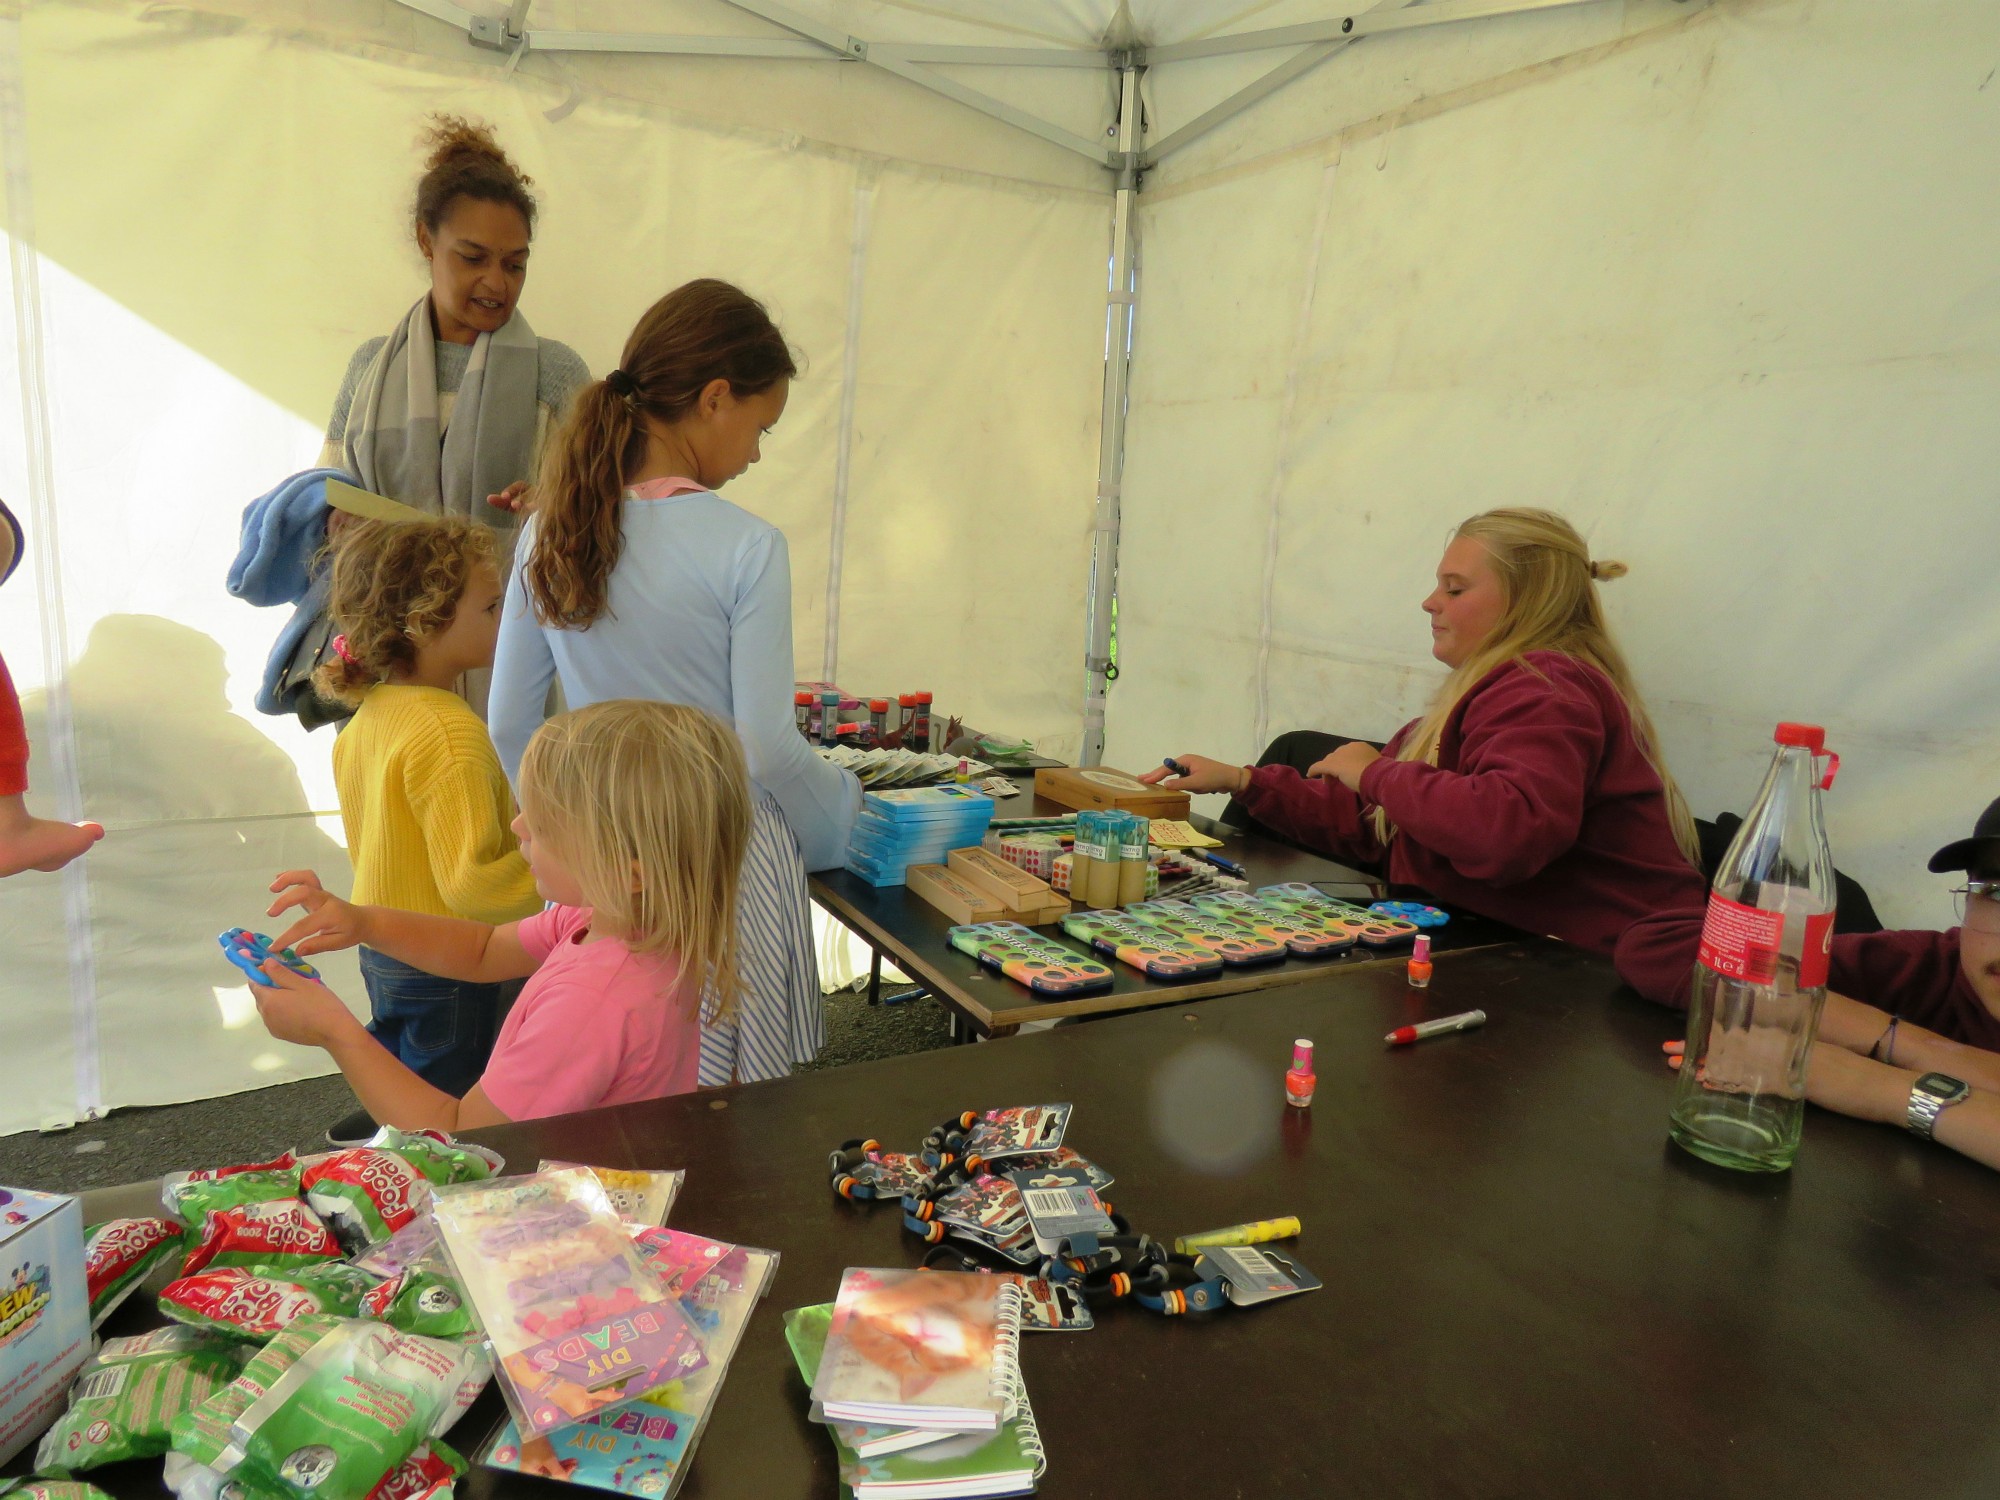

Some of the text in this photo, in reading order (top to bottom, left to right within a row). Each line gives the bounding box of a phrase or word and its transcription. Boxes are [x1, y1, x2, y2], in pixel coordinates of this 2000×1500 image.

[360, 1166, 409, 1219] Foot
[267, 1224, 327, 1252] Foot
[0, 1282, 37, 1320] EW
[533, 1311, 661, 1374] BEADS
[587, 1346, 632, 1378] DIY
[566, 1430, 620, 1455] DIY
